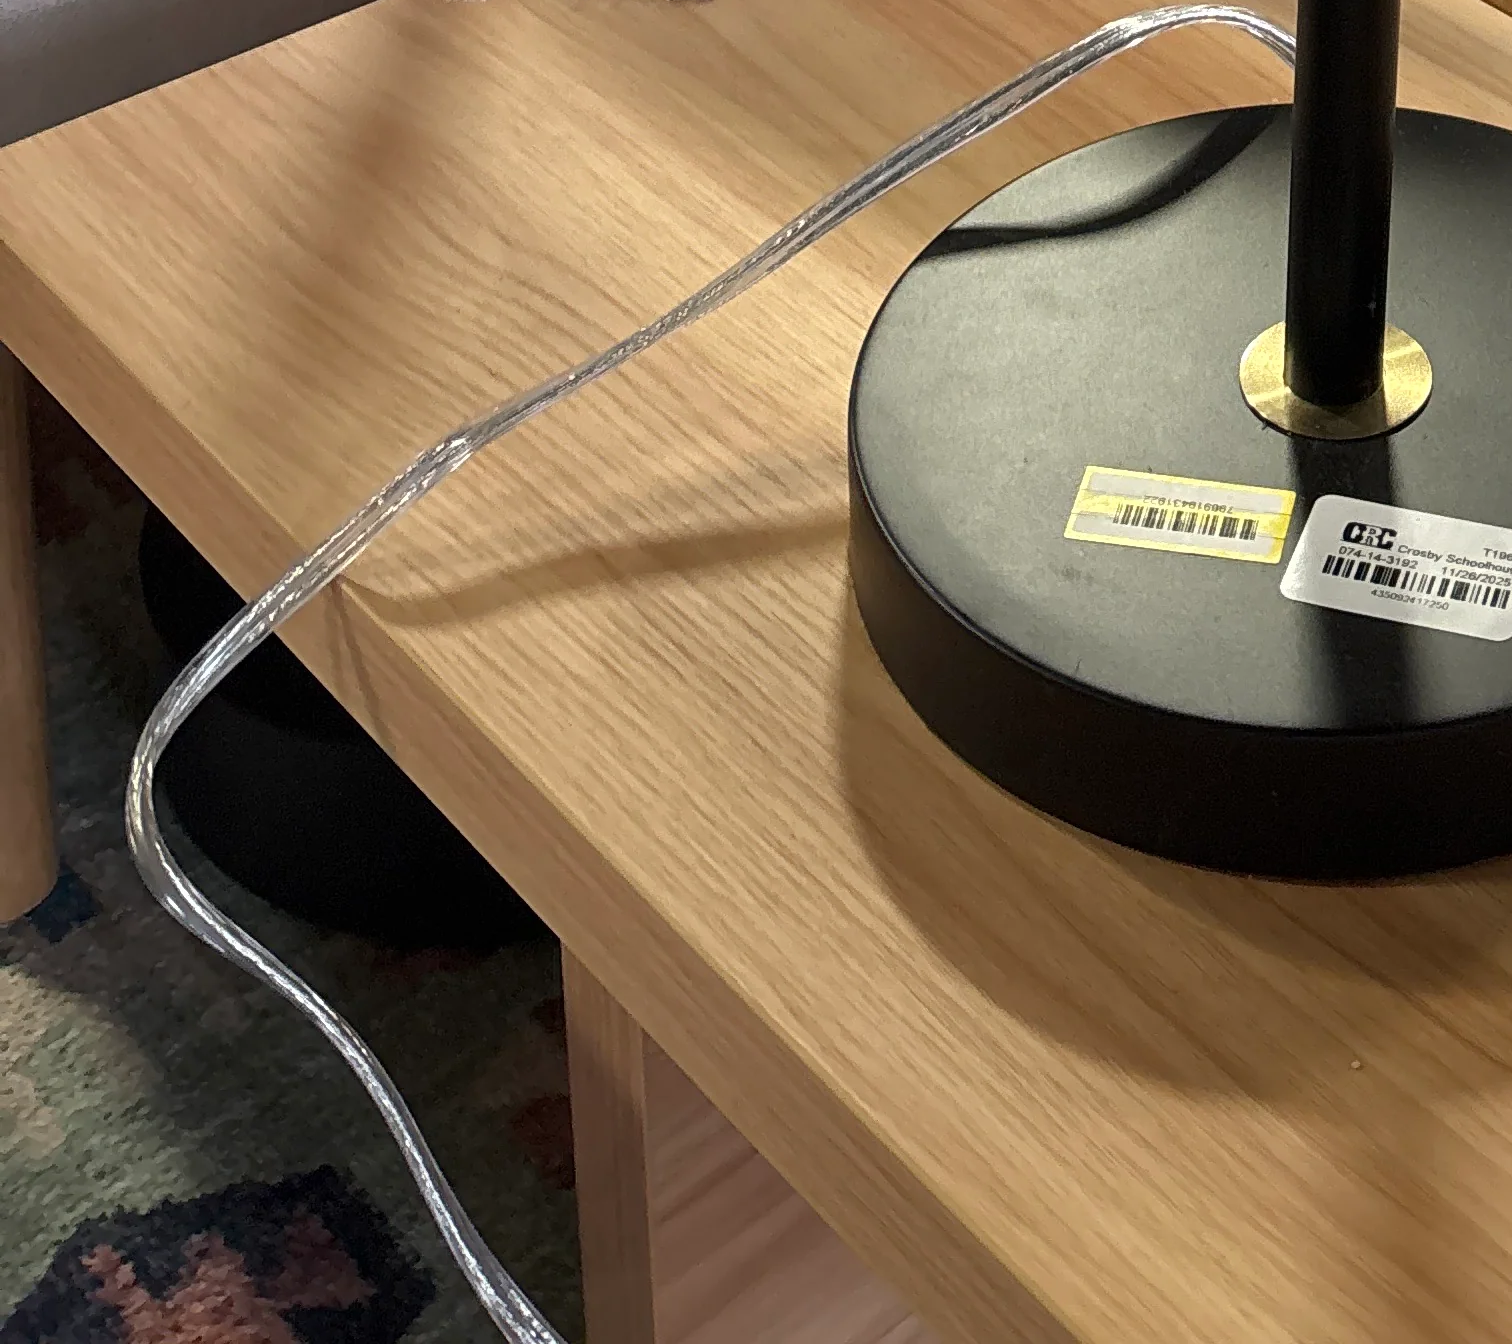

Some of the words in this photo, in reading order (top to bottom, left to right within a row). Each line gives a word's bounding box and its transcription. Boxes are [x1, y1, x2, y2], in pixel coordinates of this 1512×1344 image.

[1339, 546, 1418, 569] 074-14-3192
[1398, 545, 1443, 563] Crosby
[1442, 566, 1512, 587] 11/26/2025
